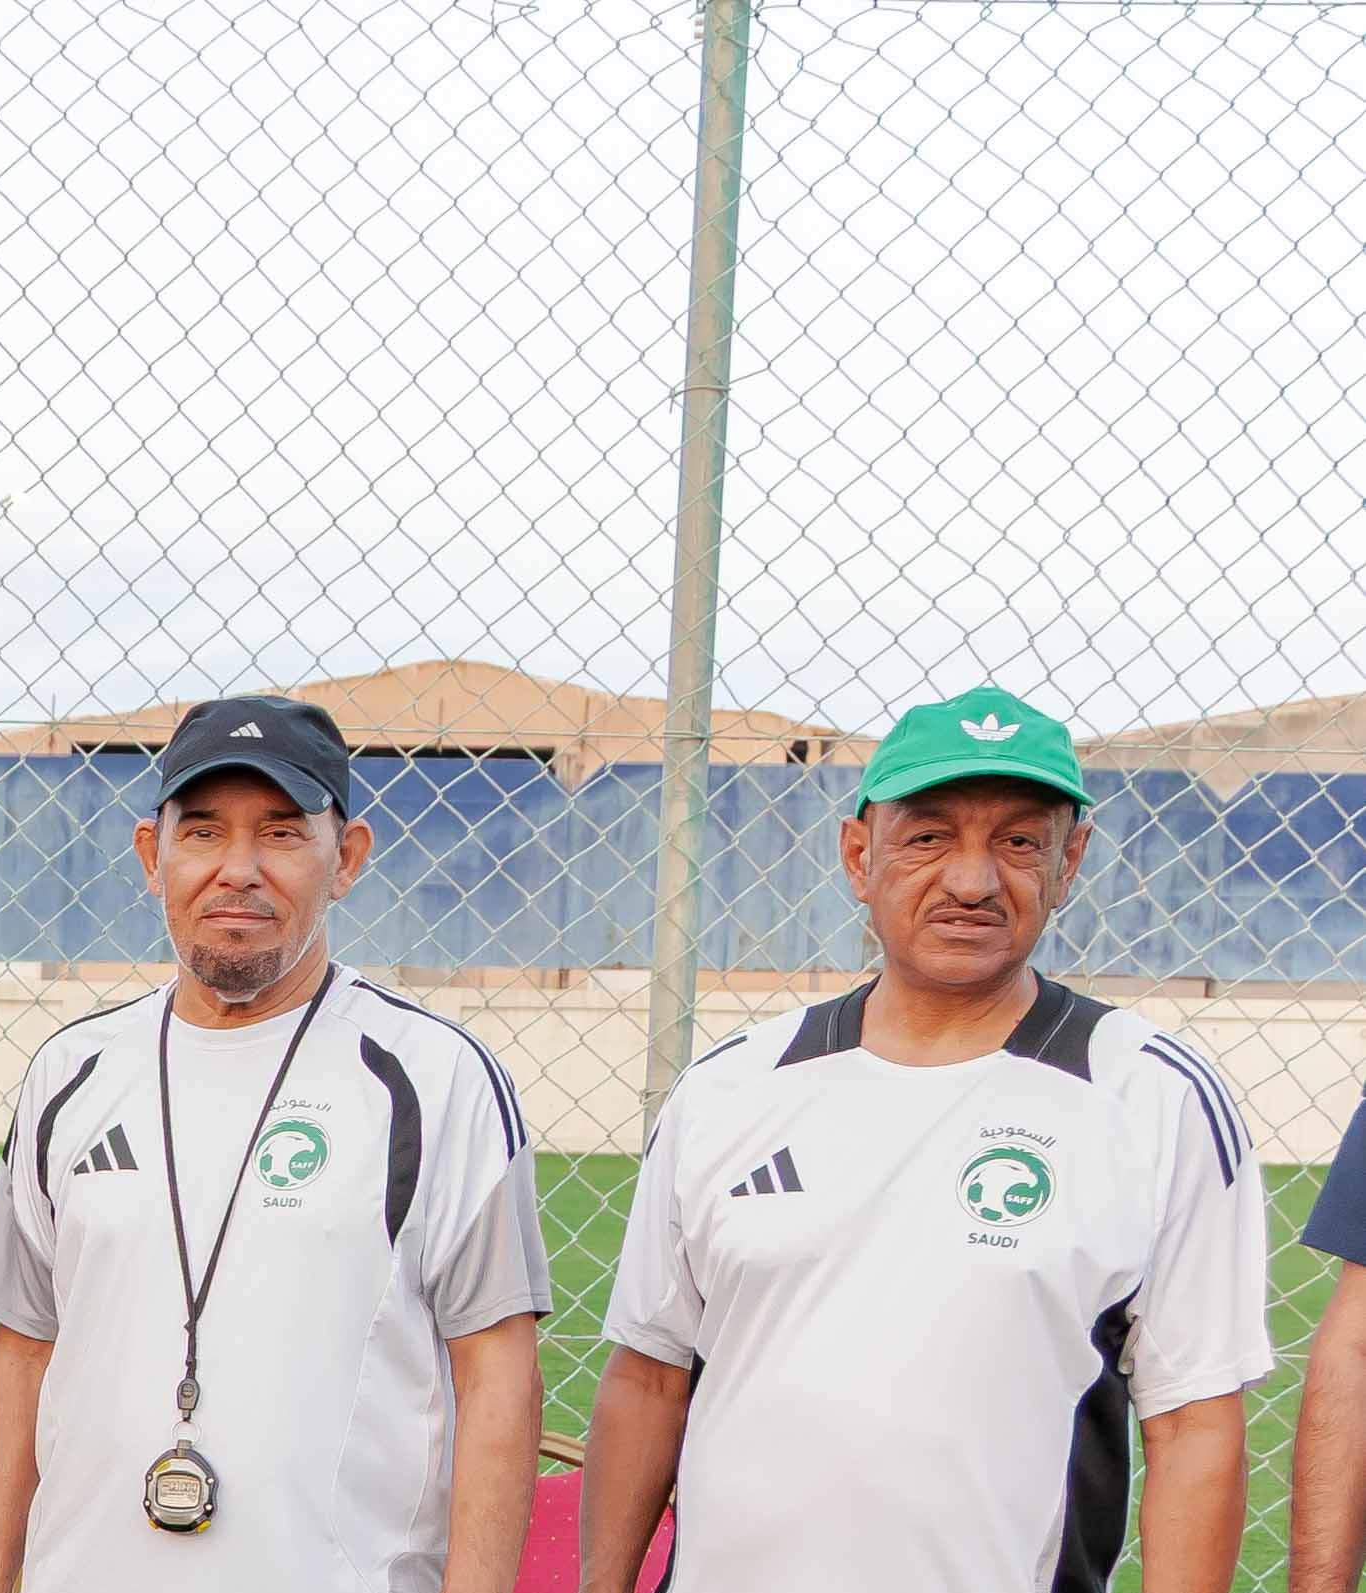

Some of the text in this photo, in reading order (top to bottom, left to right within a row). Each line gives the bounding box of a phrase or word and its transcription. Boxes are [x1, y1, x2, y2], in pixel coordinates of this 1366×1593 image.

[979, 1126, 1057, 1149] السعودية
[262, 1196, 303, 1208] SAUDI
[967, 1232, 1019, 1249] SAUDI
